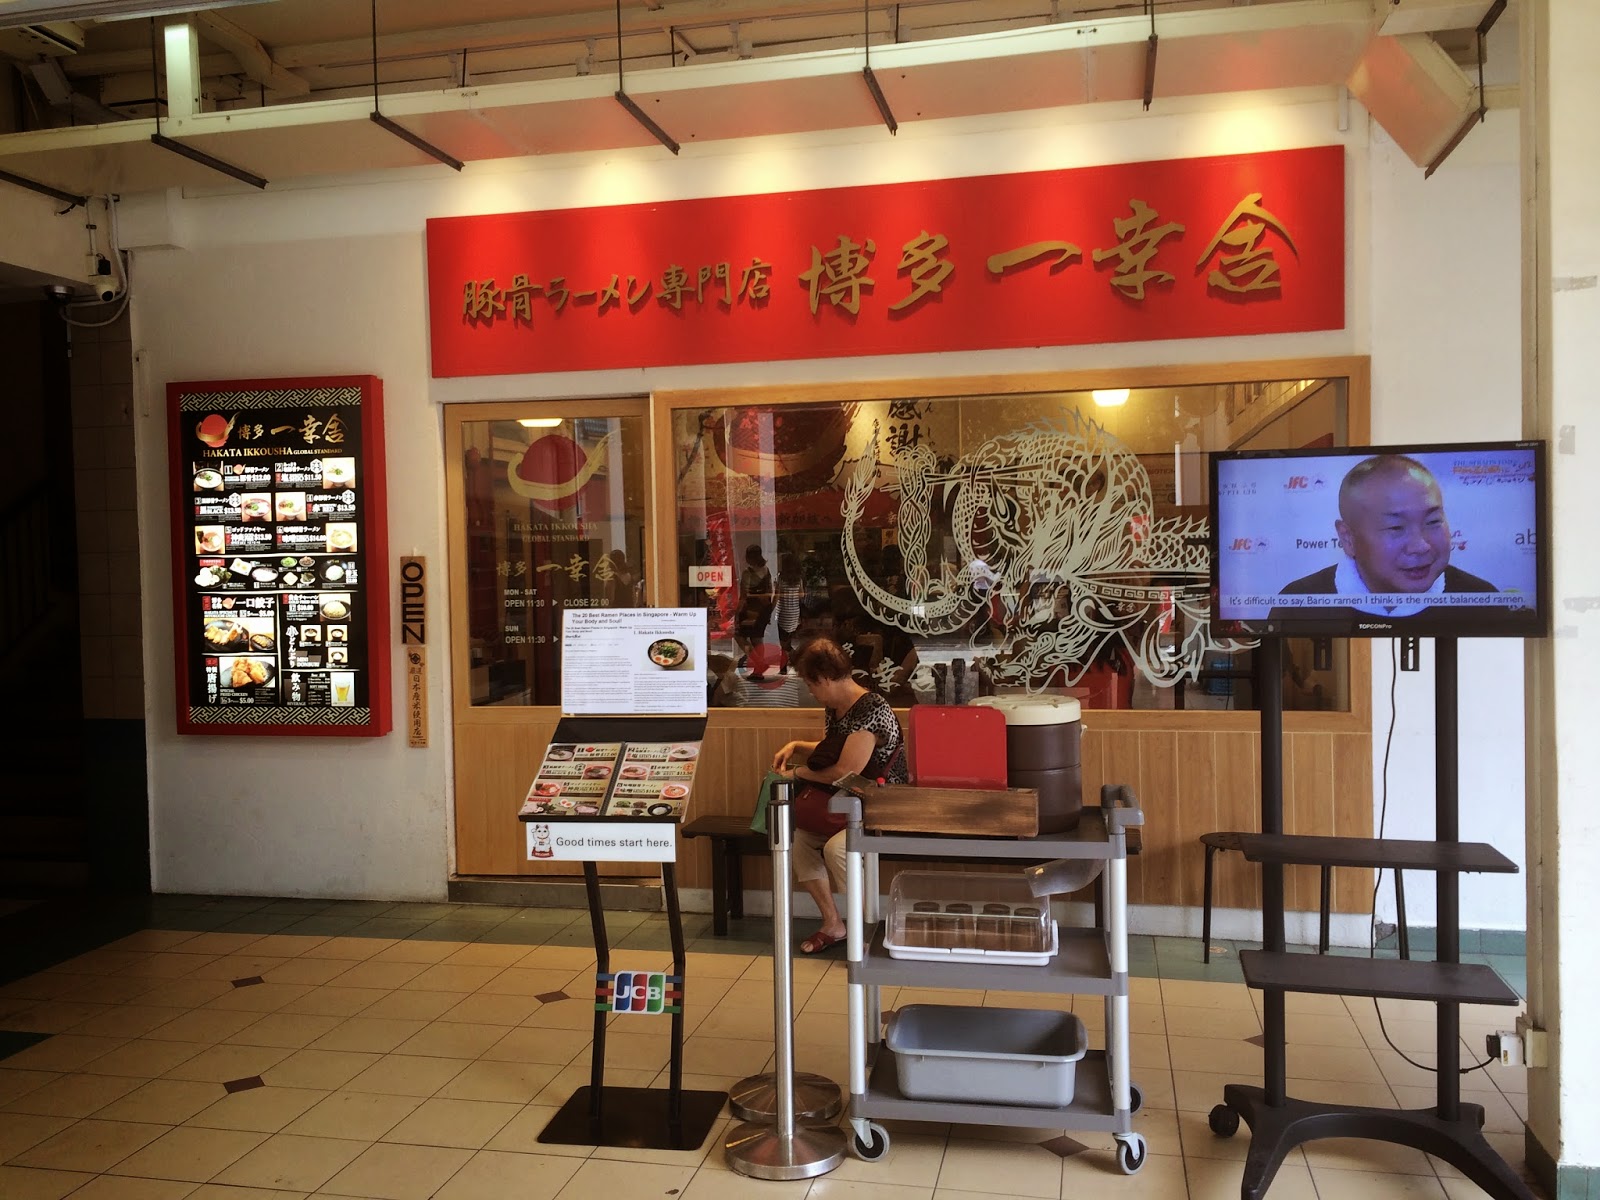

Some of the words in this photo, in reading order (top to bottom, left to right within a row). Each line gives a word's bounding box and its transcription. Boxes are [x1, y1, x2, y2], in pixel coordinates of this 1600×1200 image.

[462, 257, 772, 322] 豚骨ラーメン専門店
[202, 449, 242, 458] HAKATA
[243, 447, 293, 457] IKKOUSHA
[513, 523, 549, 531] HAKATA
[522, 535, 551, 543] GLOBAL
[551, 534, 590, 542] STANDARD
[1296, 539, 1329, 550] Power
[697, 571, 723, 582] OPEN
[402, 562, 425, 644] OPEN
[504, 599, 525, 608] OPEN
[526, 599, 545, 607] 11:30
[564, 598, 588, 607] CLOSE
[1229, 596, 1241, 605] It's
[1244, 595, 1276, 605] difficult
[1279, 597, 1288, 605] to
[1307, 595, 1330, 605] Bario
[1333, 597, 1362, 605] ramen
[1370, 594, 1393, 604] think
[1396, 594, 1403, 604] is
[1406, 594, 1421, 604] the
[1423, 595, 1448, 604] most
[1450, 593, 1490, 604] balanced
[505, 636, 526, 644] OPEN
[527, 636, 546, 644] 11:30
[285, 625, 299, 668] 小どんぶり
[291, 672, 301, 702] 飲み物
[556, 837, 584, 847] Good
[587, 837, 616, 847] times
[619, 838, 643, 847] start
[646, 838, 672, 847] here.
[616, 985, 662, 1000] JCB
